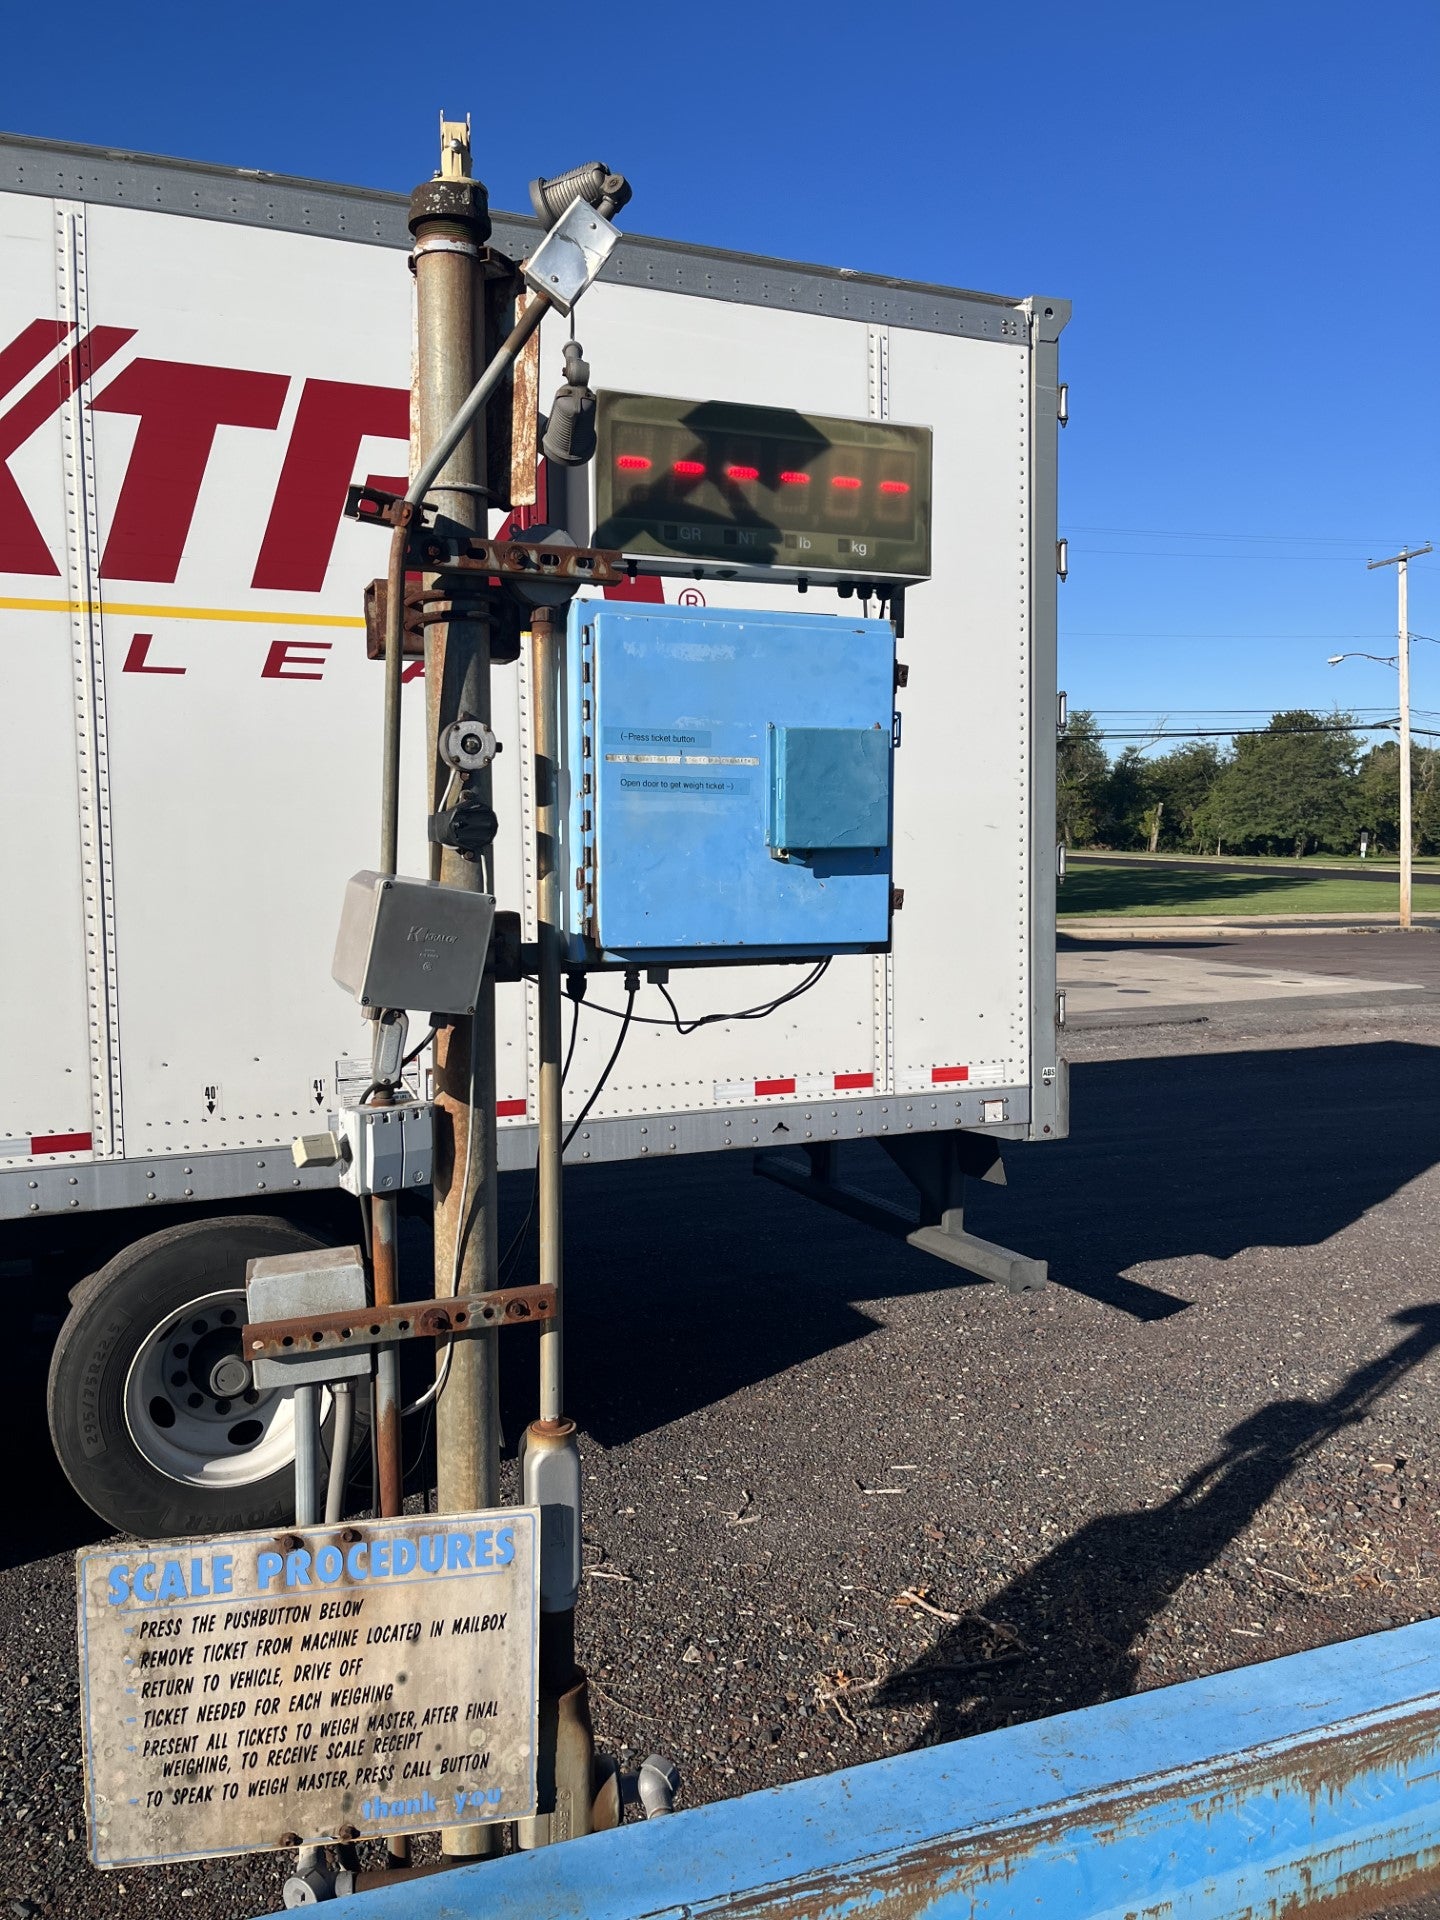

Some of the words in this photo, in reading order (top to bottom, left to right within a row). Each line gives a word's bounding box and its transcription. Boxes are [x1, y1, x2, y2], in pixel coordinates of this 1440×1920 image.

[680, 527, 702, 541] GR
[738, 531, 758, 546] NT
[799, 537, 811, 550] lb
[851, 540, 867, 556] kg
[651, 732, 671, 742] ticket
[672, 733, 696, 744] button
[620, 778, 641, 789] Open
[643, 779, 659, 788] door
[661, 780, 668, 788] to
[670, 781, 681, 790] get
[683, 781, 704, 791] weigh
[706, 782, 725, 790] ticket
[1043, 1068, 1055, 1076] ABS
[108, 1555, 233, 1606] SCALE
[257, 1527, 516, 1590] PROCEDURES
[139, 1618, 183, 1639] PRESS
[192, 1614, 217, 1634] THE
[224, 1604, 312, 1630] PUSHBUTTON
[319, 1599, 364, 1620] BELOW
[140, 1647, 195, 1669] REMOVE
[203, 1641, 248, 1663] TICKET
[256, 1636, 292, 1657] FROM
[300, 1629, 359, 1651] MACHINE
[366, 1622, 422, 1645] LOCATED
[430, 1620, 445, 1638] IN
[452, 1613, 507, 1635] MAILBOX
[141, 1677, 195, 1699] RETURN
[203, 1674, 220, 1693] TO
[230, 1667, 284, 1690] VEHICLE,
[293, 1661, 332, 1682] DRIVE
[339, 1658, 364, 1677] OFF
[144, 1706, 189, 1729] TICKET
[196, 1701, 247, 1723] NEEDED
[254, 1697, 281, 1717] FOR
[288, 1691, 322, 1713] EACH
[330, 1683, 394, 1708] WEIGHING
[142, 1735, 199, 1757] PRESENT
[205, 1732, 228, 1751] ALL
[237, 1725, 288, 1748] TICKETS
[296, 1723, 312, 1742] TO
[320, 1716, 359, 1738] WEIGH
[367, 1710, 418, 1732] MASTER,
[421, 1705, 459, 1726] AFTER
[465, 1701, 498, 1720] FINAL
[163, 1754, 231, 1777] WEIGHING,
[241, 1751, 258, 1770] TO
[266, 1744, 319, 1767] RECEIVE
[325, 1739, 365, 1759] SCALE
[373, 1731, 424, 1754] RECEIPT
[147, 1790, 163, 1808] TO
[172, 1784, 215, 1805] SPEAK
[222, 1782, 239, 1801] TO
[248, 1776, 290, 1798] WEIGH
[296, 1769, 350, 1792] MASTER,
[355, 1764, 395, 1785] PRESS
[402, 1760, 432, 1779] CALL
[440, 1752, 491, 1774] BUTTON
[361, 1789, 438, 1820] thank
[453, 1787, 503, 1815] you
